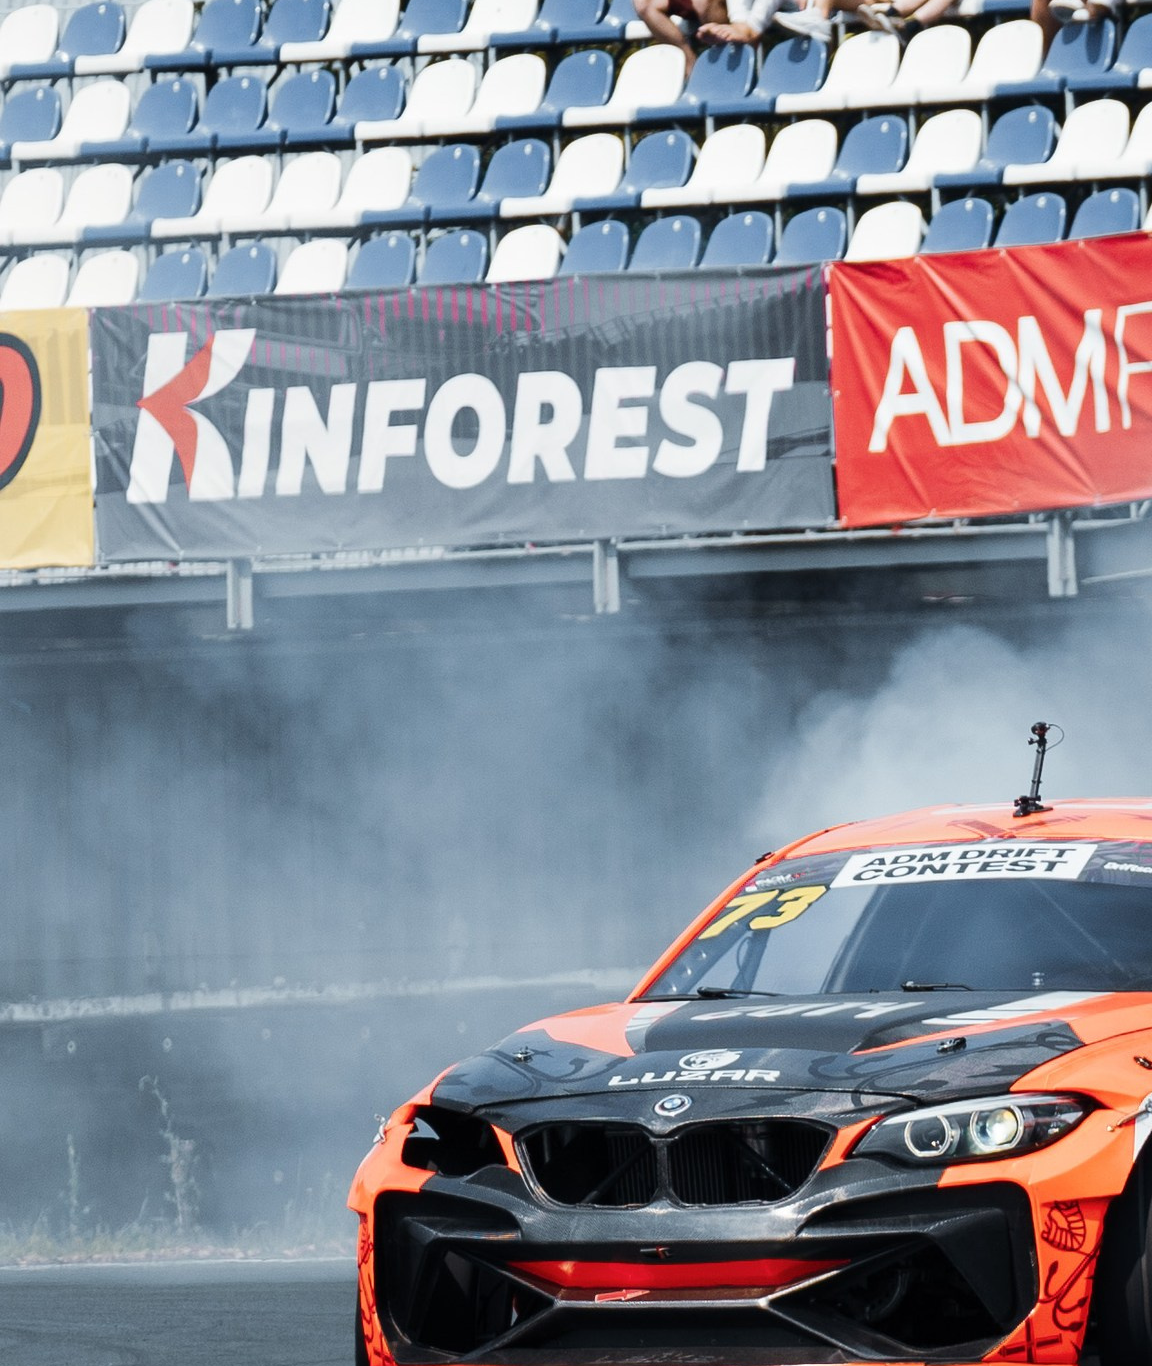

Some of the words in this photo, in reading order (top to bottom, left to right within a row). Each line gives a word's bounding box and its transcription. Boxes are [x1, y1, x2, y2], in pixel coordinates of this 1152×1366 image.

[126, 327, 795, 504] KINFOREST
[864, 850, 949, 868] ADM
[957, 847, 1077, 861] DRIFT
[852, 859, 1068, 881] CONTEST
[697, 885, 827, 940] 73
[608, 1069, 780, 1086] LUZAR
